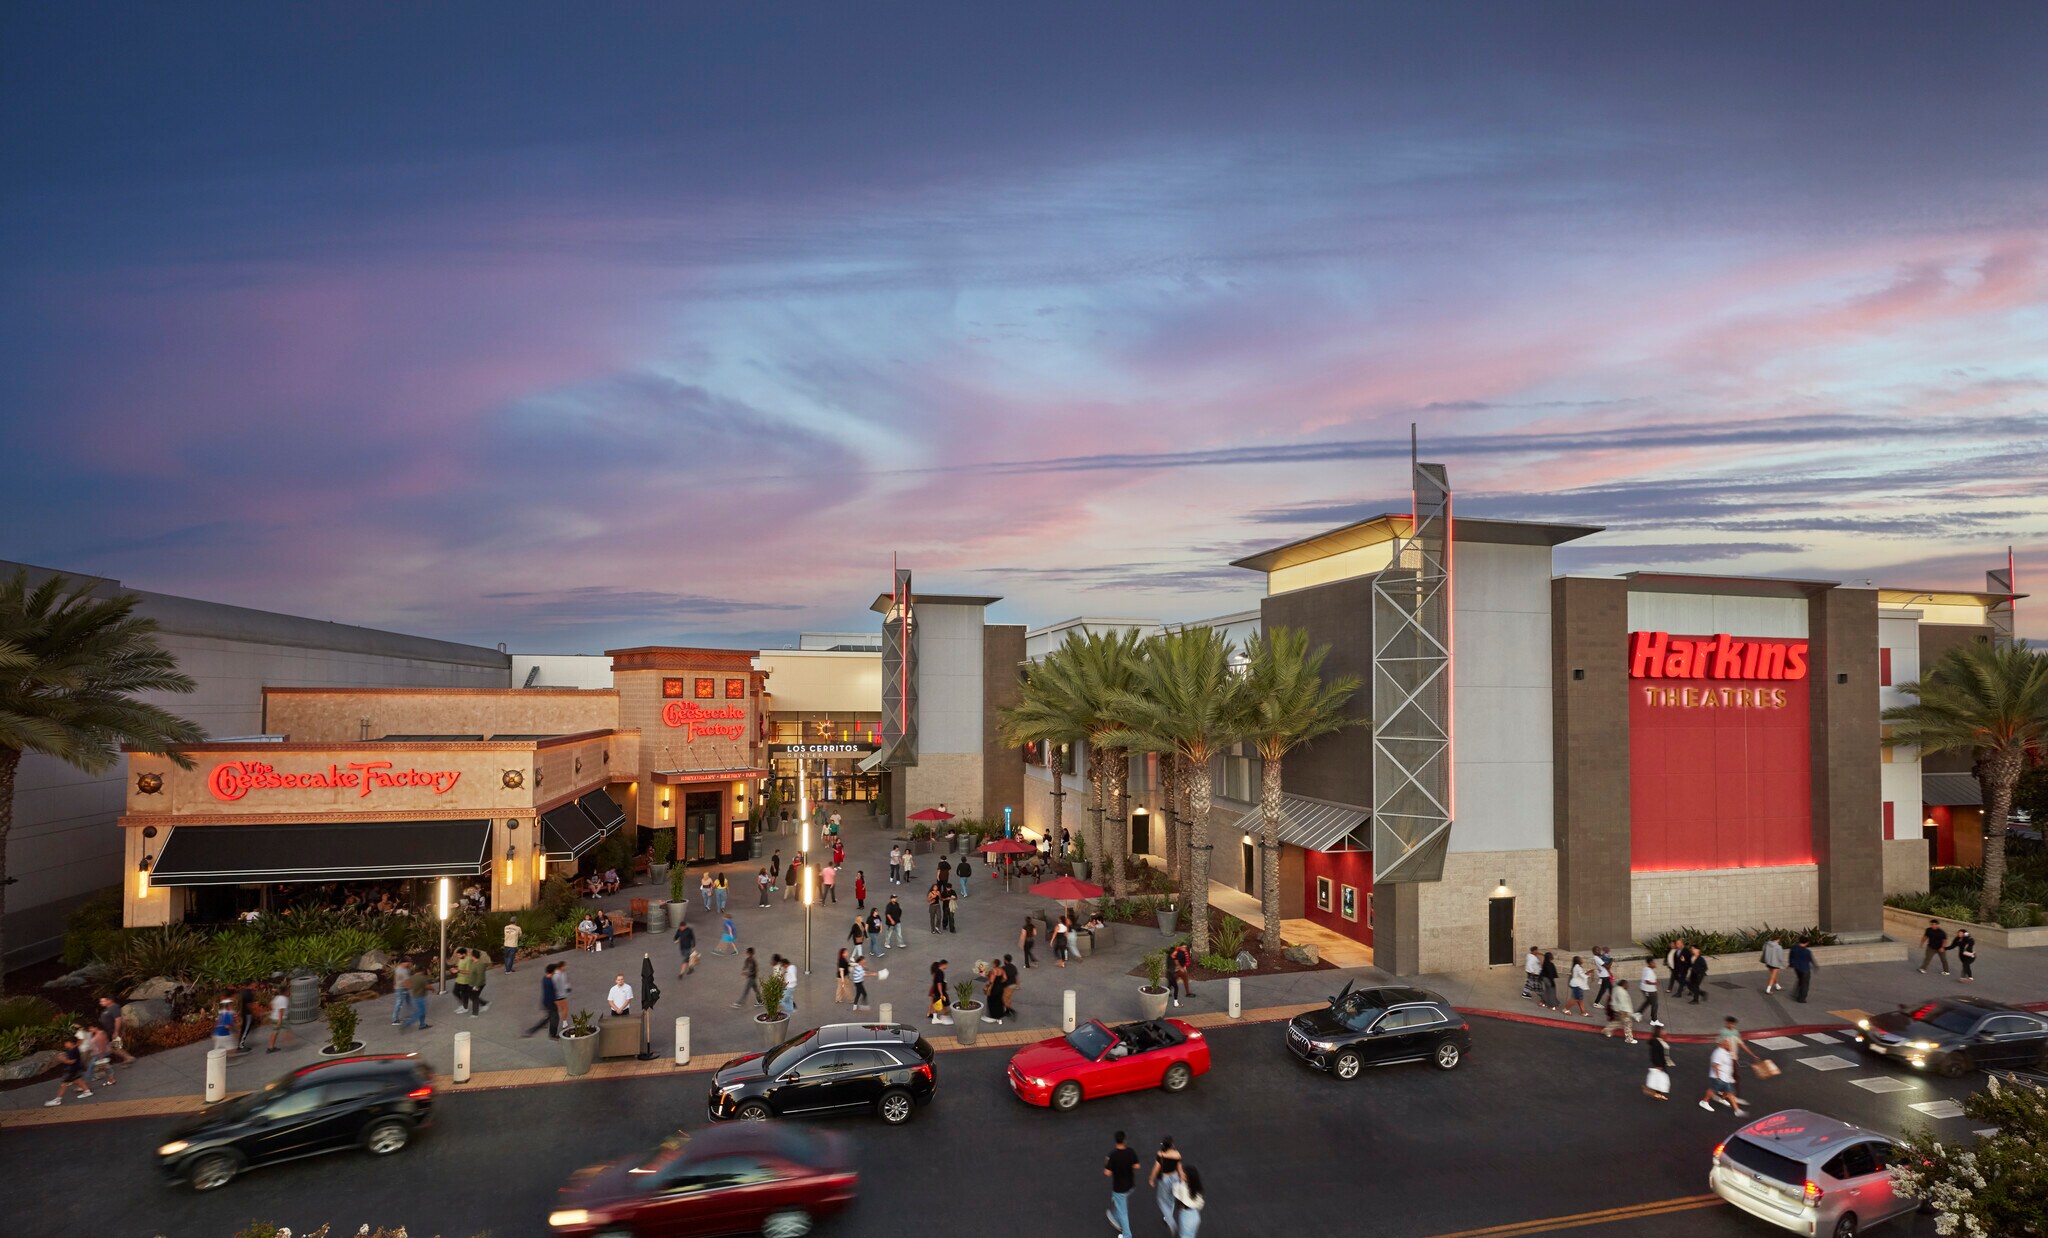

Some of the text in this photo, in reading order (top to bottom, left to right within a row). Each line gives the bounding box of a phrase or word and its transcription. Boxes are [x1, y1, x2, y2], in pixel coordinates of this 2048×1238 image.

[1630, 631, 1808, 680] Harkins
[685, 701, 699, 710] The
[1647, 688, 1788, 708] THEATRES
[662, 701, 745, 728] Cheesecake
[680, 719, 745, 743] Factory
[246, 761, 273, 774] The
[207, 761, 461, 800] Cheesecake Factory
